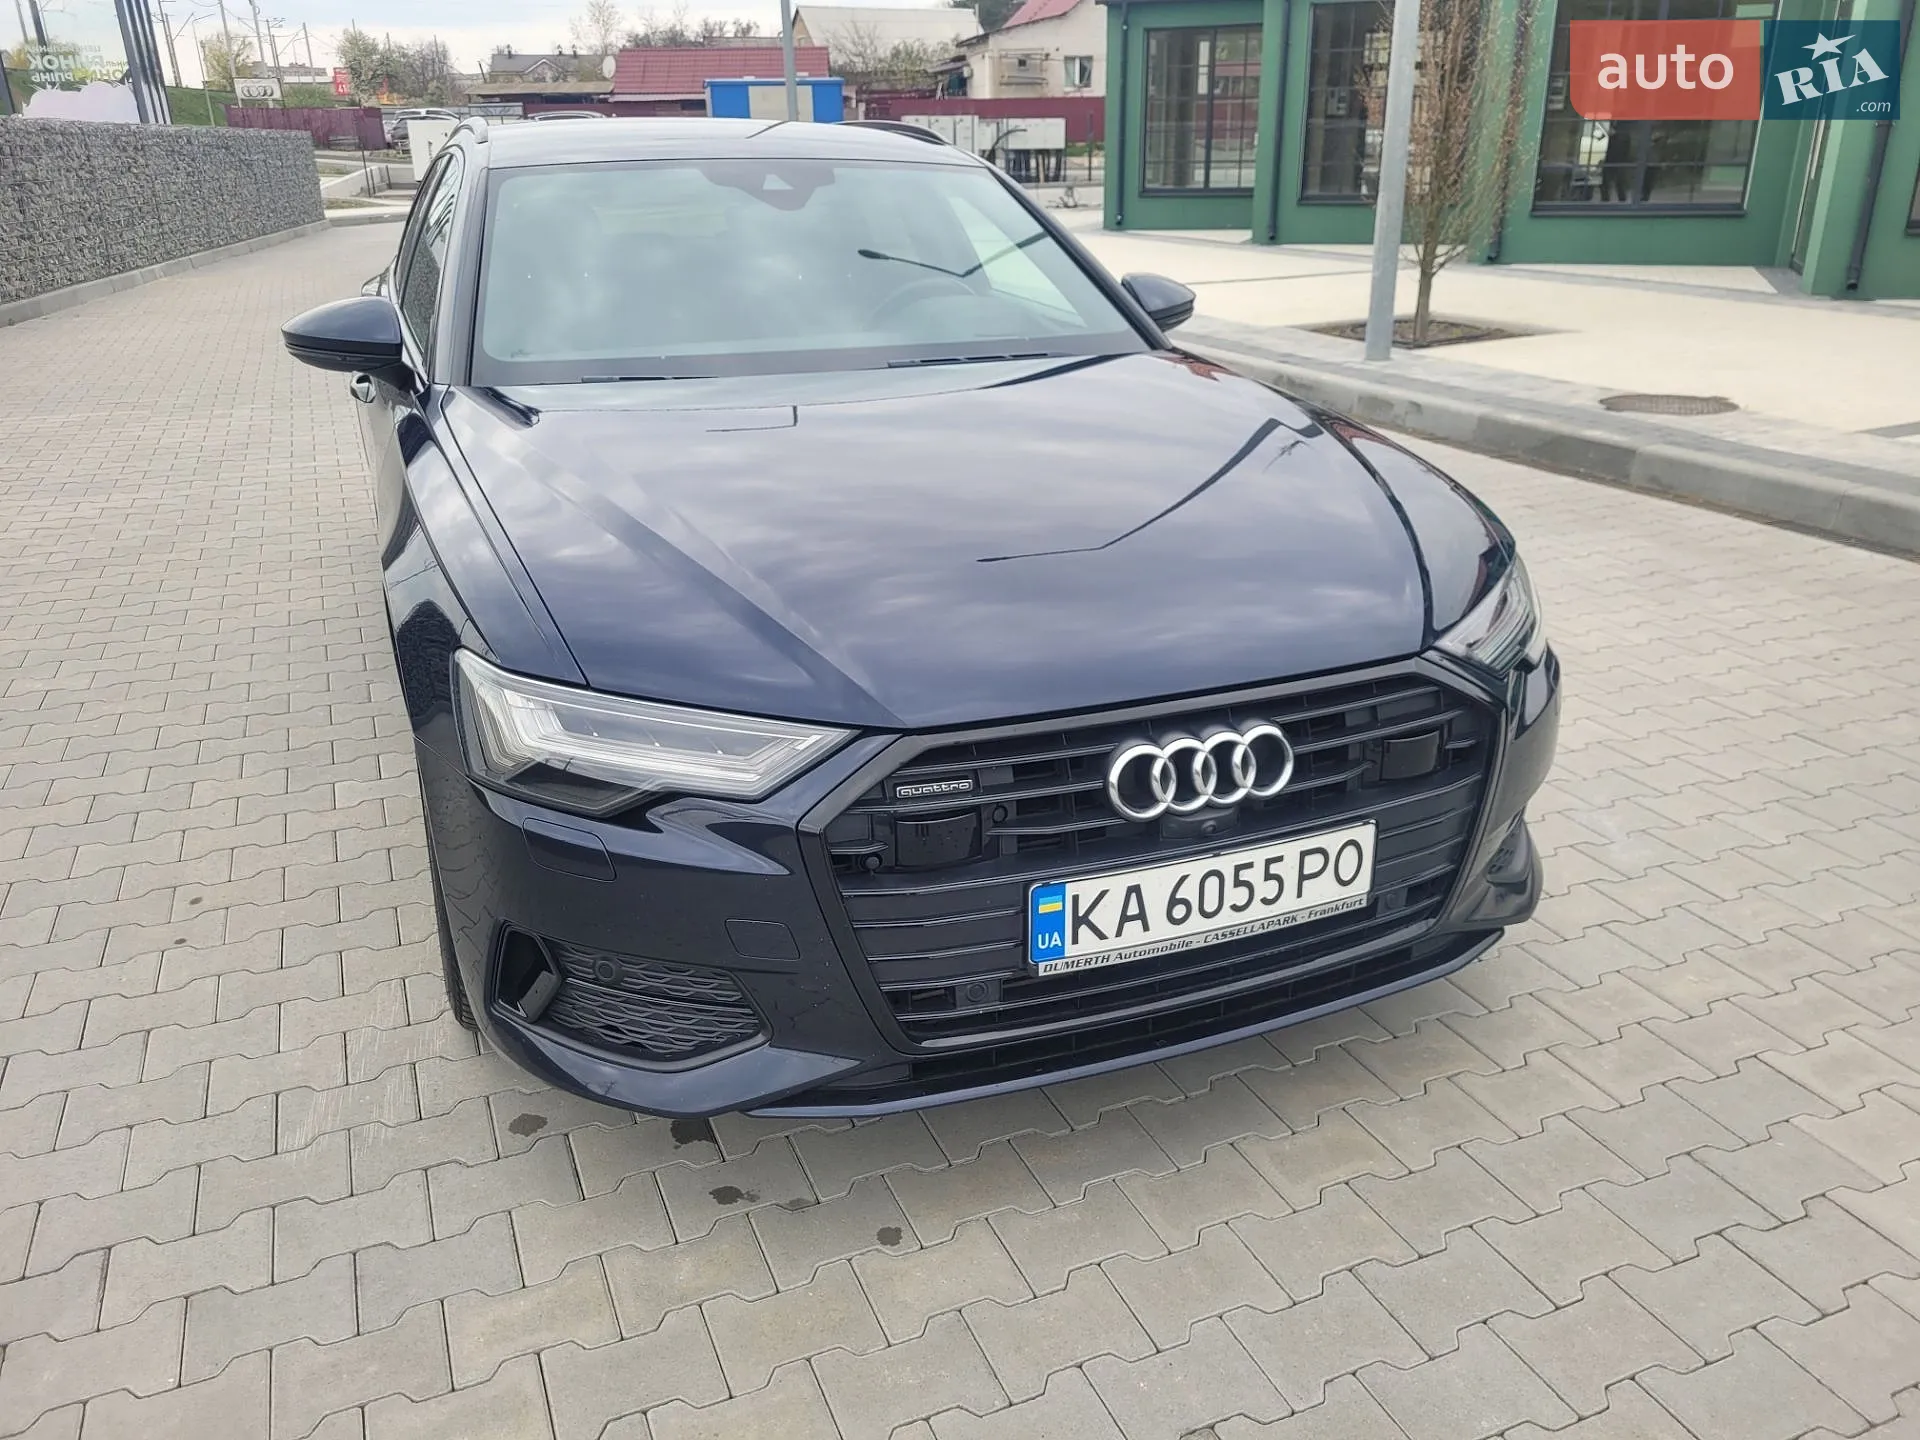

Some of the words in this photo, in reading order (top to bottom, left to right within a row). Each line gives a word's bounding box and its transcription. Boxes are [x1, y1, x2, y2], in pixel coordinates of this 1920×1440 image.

[900, 782, 970, 797] quattro
[1071, 883, 1151, 946] KA
[1165, 854, 1285, 927] 6055
[1296, 838, 1364, 899] PO
[1037, 933, 1062, 950] UA
[1113, 939, 1193, 962] Automobile
[1203, 913, 1298, 944] CASSELLAPARK
[1307, 897, 1364, 919] Frankfurt
